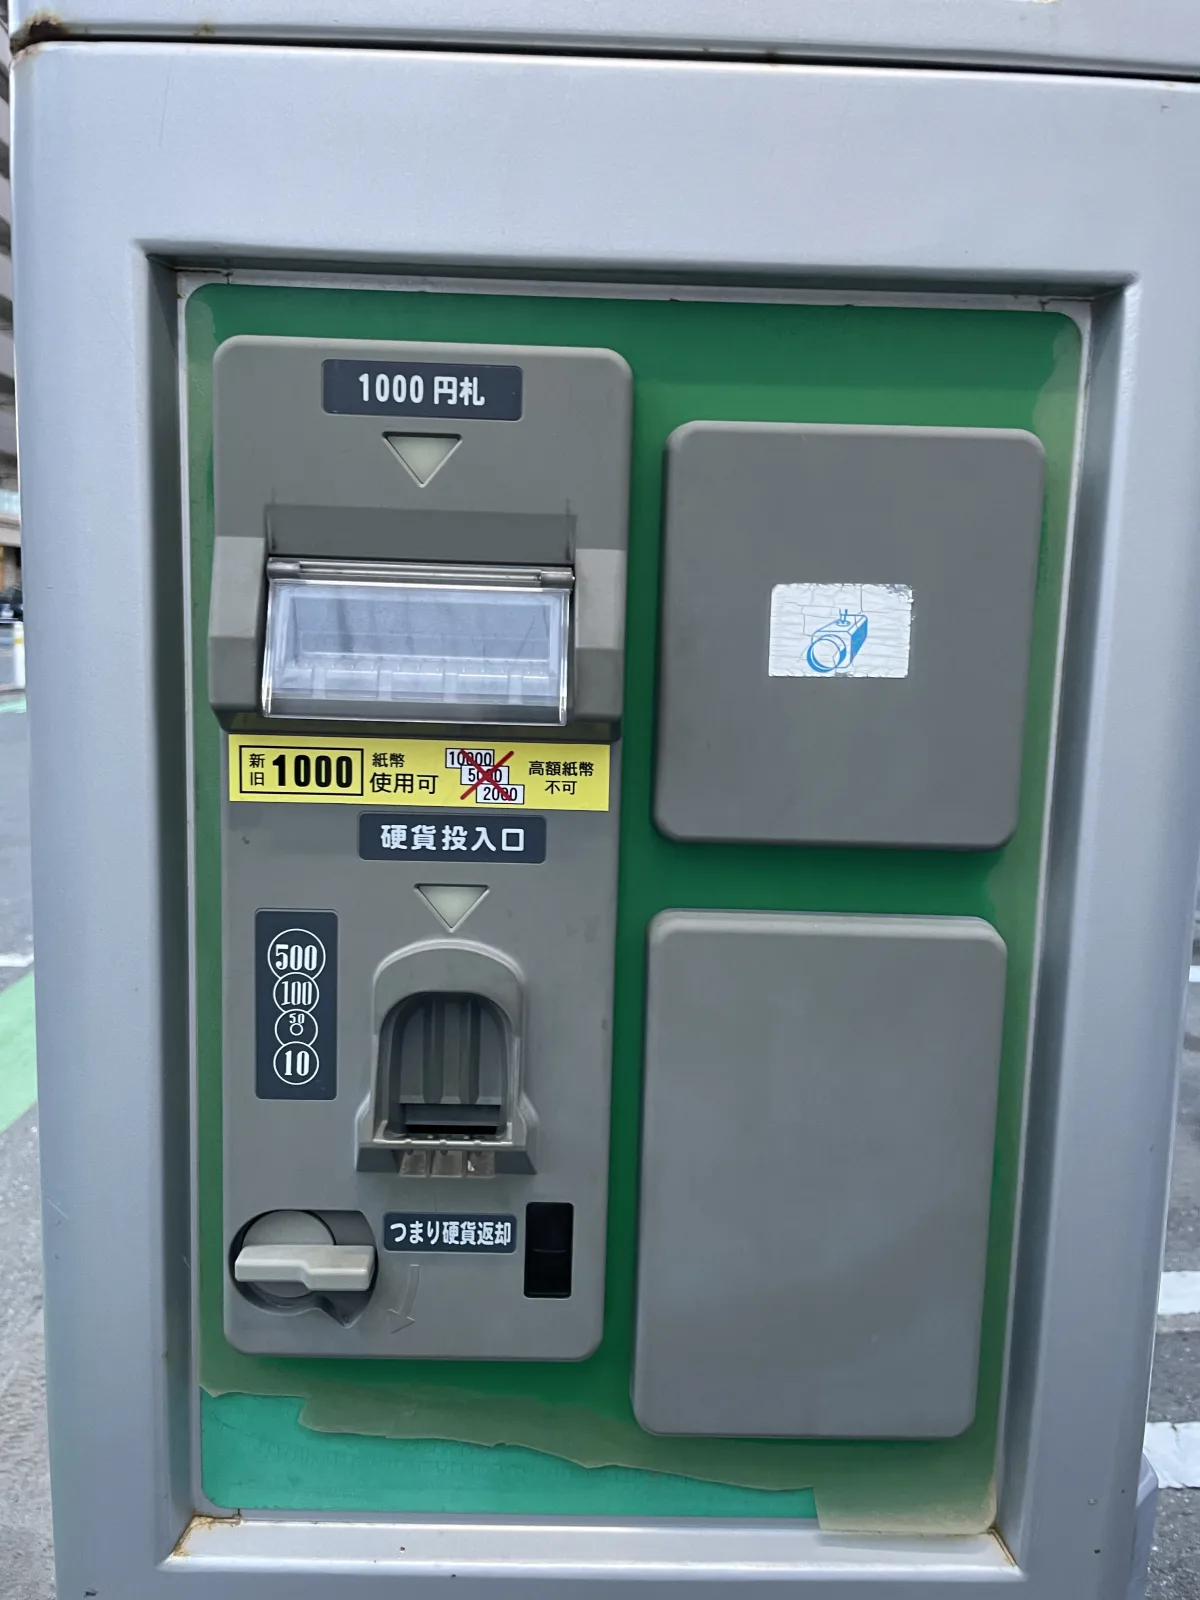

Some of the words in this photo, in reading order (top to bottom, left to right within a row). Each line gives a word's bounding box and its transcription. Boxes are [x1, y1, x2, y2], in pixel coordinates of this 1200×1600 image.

[358, 373, 424, 404] 1000
[433, 376, 486, 406] 円札
[249, 753, 265, 769] 新
[272, 754, 353, 788] 1000
[372, 752, 405, 768] 紙幣
[528, 761, 594, 777] 高額紙幣
[250, 771, 265, 787] 旧
[369, 772, 439, 795] 使用可
[544, 780, 577, 796] 不可
[380, 824, 525, 852] 硬貨投入口
[275, 943, 318, 971] 500
[280, 981, 313, 1006] 100
[289, 1013, 305, 1024] 50
[284, 1050, 310, 1077] 10
[390, 1220, 512, 1246] つまり硬貨返却
